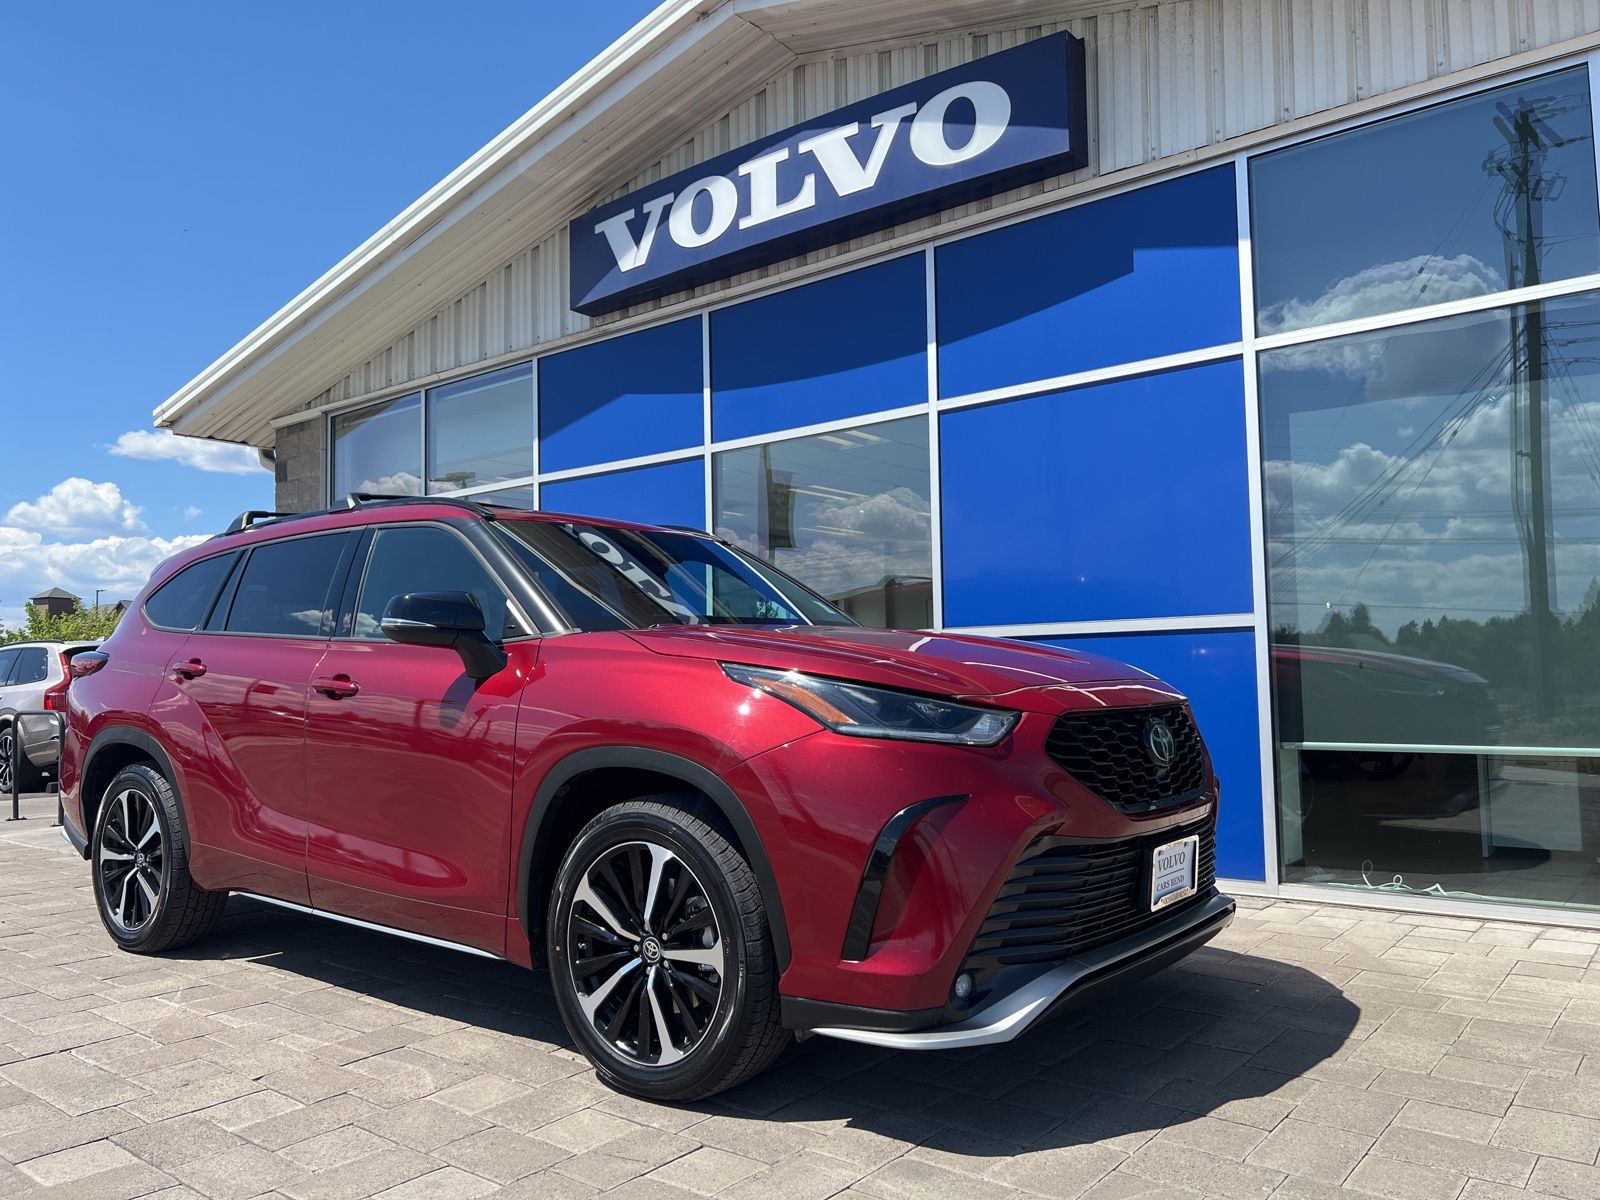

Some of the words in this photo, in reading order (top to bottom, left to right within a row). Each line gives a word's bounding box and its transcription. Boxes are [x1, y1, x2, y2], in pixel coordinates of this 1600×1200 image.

[594, 80, 1012, 273] VOLVO
[1157, 851, 1186, 872] VOLVO
[1156, 879, 1170, 892] CARS
[1170, 874, 1185, 887] BEND
